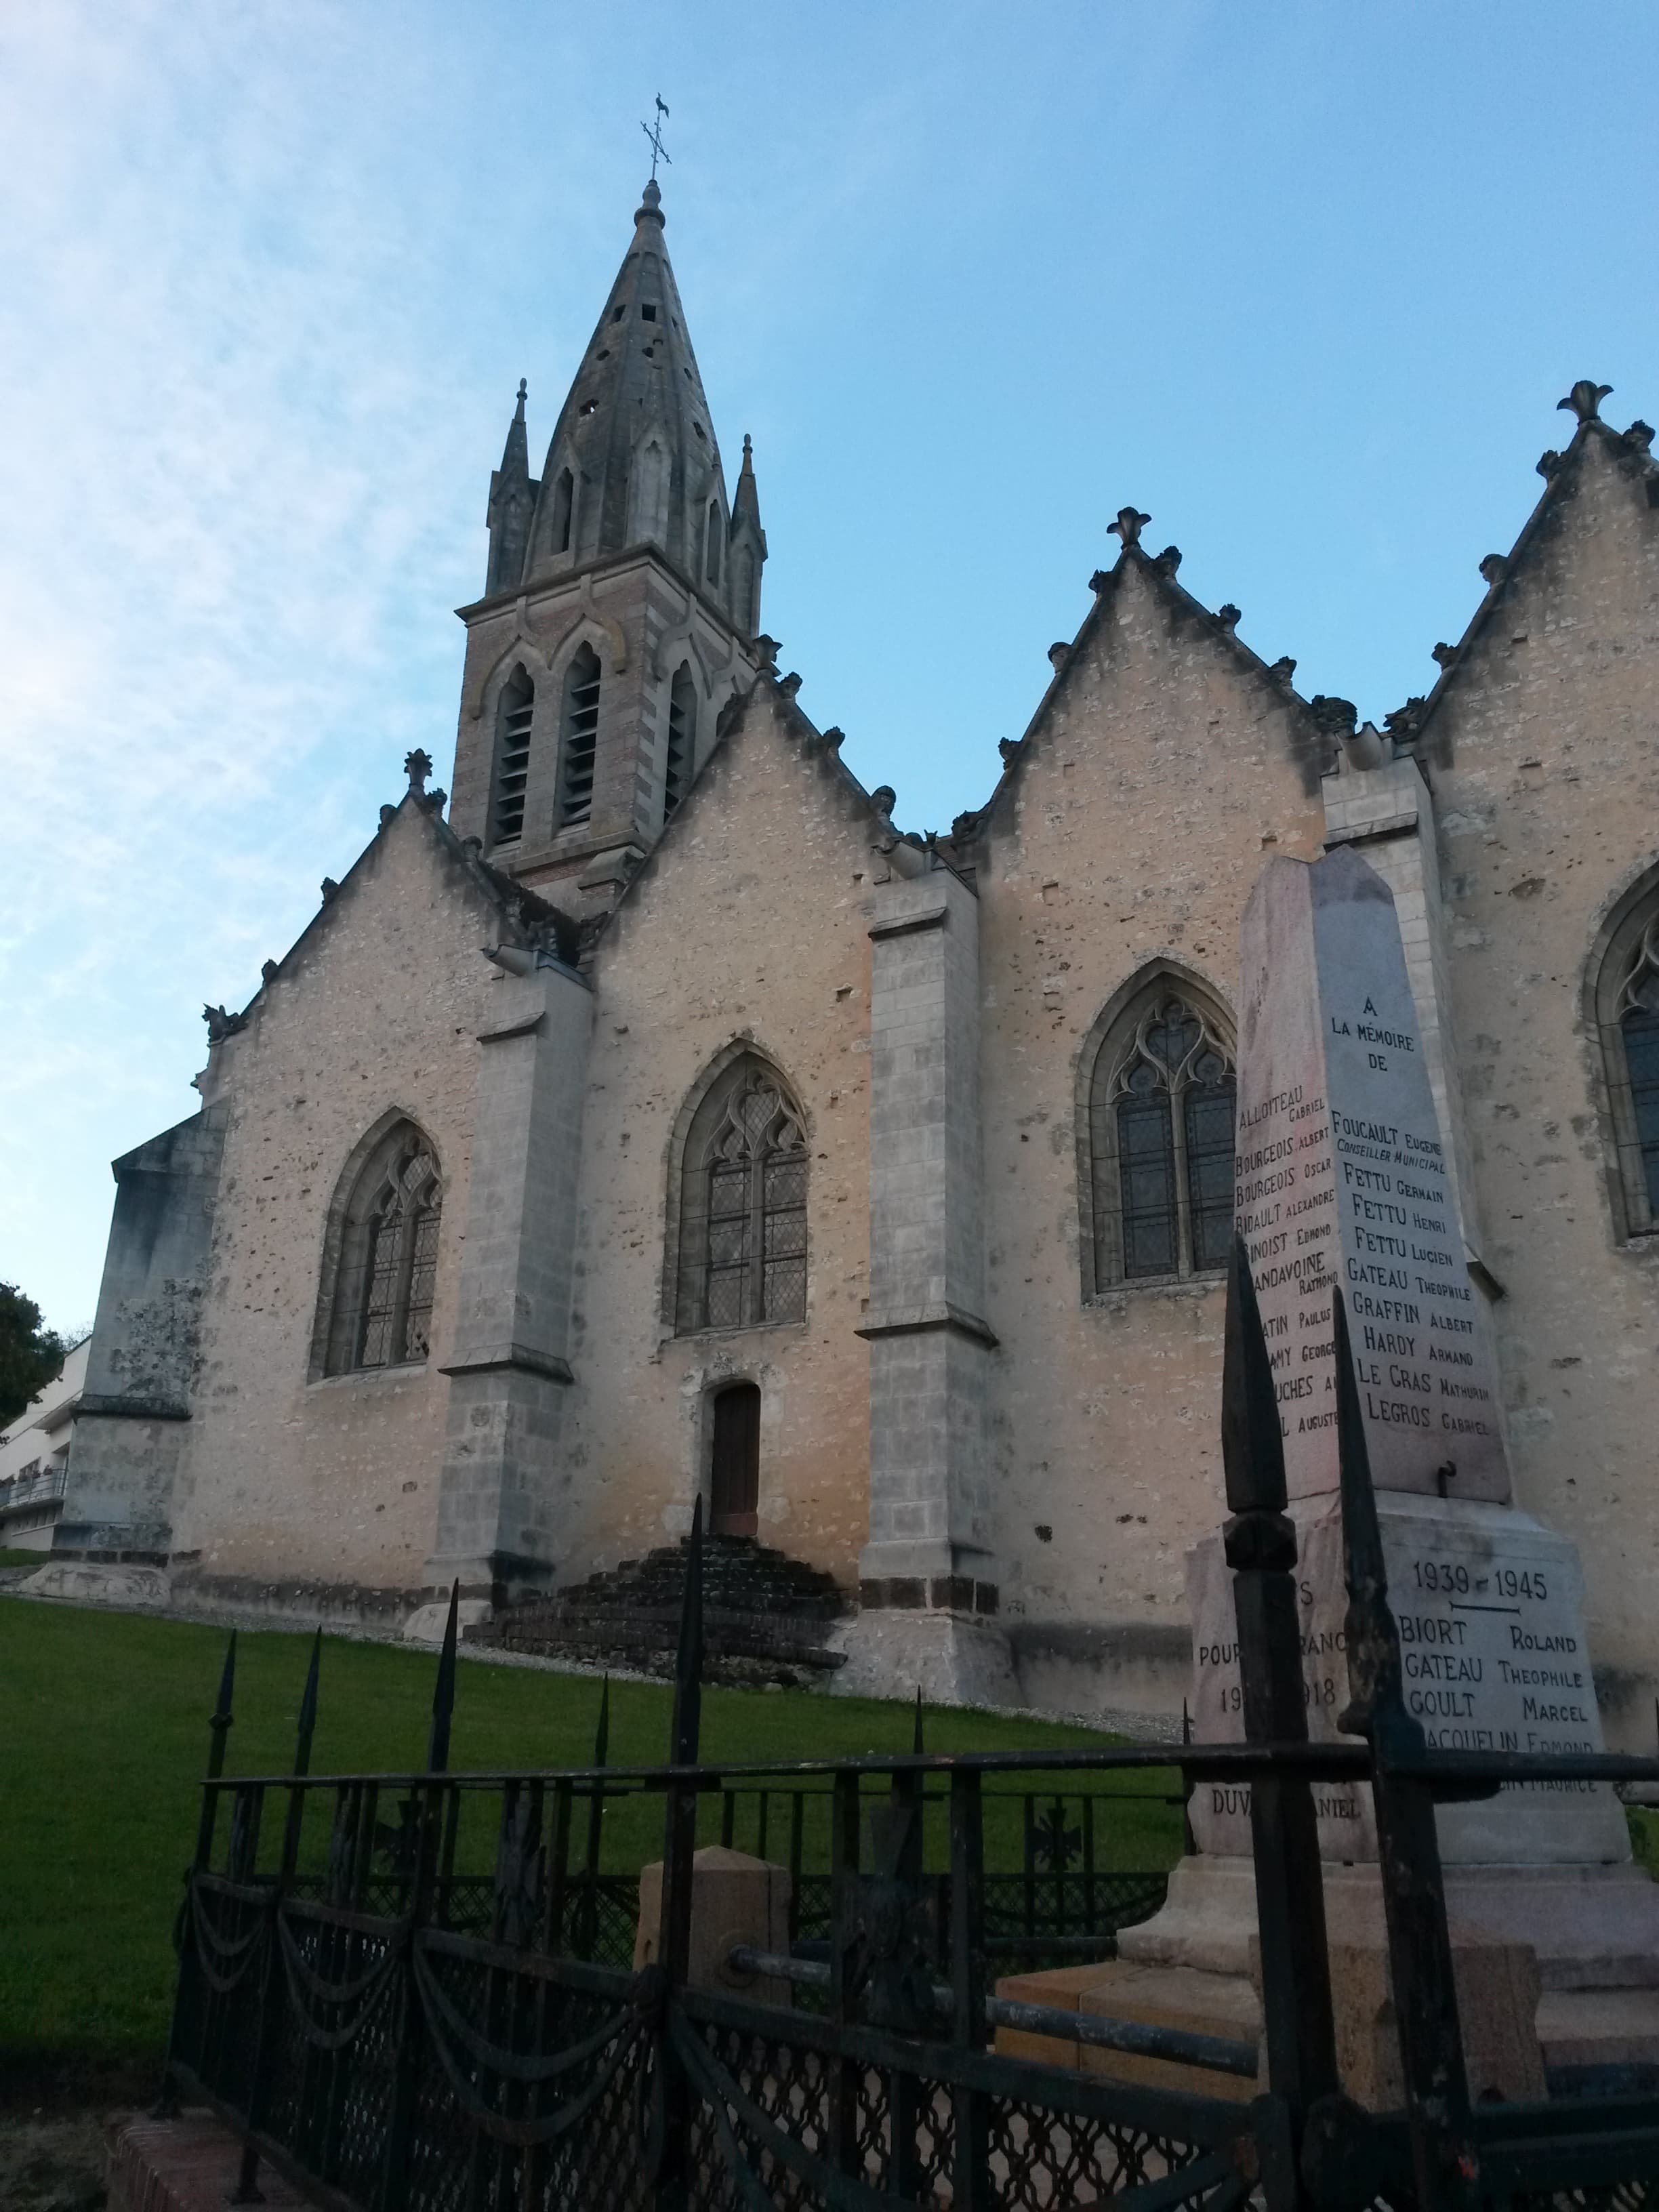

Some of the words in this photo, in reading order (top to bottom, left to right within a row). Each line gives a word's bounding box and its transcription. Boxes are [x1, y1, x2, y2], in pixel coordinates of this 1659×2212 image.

[1363, 996, 1378, 1016] A
[1332, 1018, 1350, 1036] LA
[1357, 1022, 1414, 1052] MÉMOIRE
[1368, 1054, 1387, 1071] DE
[1240, 1085, 1303, 1130] ALLOITEAU
[1289, 1098, 1325, 1122] GABRIEL
[1331, 1110, 1398, 1145] FOUCAULT
[1405, 1134, 1442, 1155] EUGENE
[1236, 1137, 1293, 1177] BOURGEOIS
[1299, 1127, 1329, 1150] ALBERT
[1337, 1139, 1391, 1162] CONSEILLER
[1394, 1151, 1445, 1174] MUNICIPAL
[1237, 1168, 1294, 1207] BOURGEOIS
[1305, 1158, 1331, 1179] OSCAR
[1343, 1162, 1391, 1192] FETTU
[1397, 1181, 1443, 1204] GERMAIN
[1236, 1203, 1281, 1236] BIDAULT
[1286, 1189, 1334, 1218] ALEXANDRE
[1352, 1193, 1406, 1225] FETTU
[1413, 1213, 1446, 1233] HENRI
[1297, 1224, 1331, 1246] EDMOND
[1355, 1226, 1406, 1258] FETTU
[1411, 1244, 1453, 1266] LUCIEN
[1254, 1252, 1325, 1292] ANDAVOINE
[1347, 1258, 1408, 1290] GATEAU
[1415, 1277, 1471, 1301] THEOPHILE
[1263, 1315, 1288, 1338] ATIN
[1299, 1309, 1330, 1328] PAULUS
[1353, 1292, 1420, 1324] GRAFFIN
[1431, 1313, 1473, 1334] ALBERT
[1270, 1347, 1291, 1370] AMY
[1364, 1326, 1415, 1356] HARDY
[1429, 1345, 1473, 1366] ARMAND
[1275, 1375, 1313, 1402] UCHES
[1357, 1358, 1380, 1385] LE
[1389, 1365, 1431, 1393] GRAS
[1440, 1378, 1490, 1401] MATHURIN
[1298, 1412, 1338, 1433] AUGUSTE
[1367, 1393, 1430, 1427] LEGROS
[1441, 1413, 1490, 1435] GABRIEL
[1300, 1632, 1346, 1655] RANC
[1399, 1616, 1467, 1645] BIORT
[1510, 1626, 1576, 1652] ROLAND
[1405, 1654, 1482, 1682] GATEAU
[1498, 1660, 1583, 1687] THEOPHILE
[1410, 1691, 1475, 1717] GOULT
[1523, 1696, 1588, 1722] MARCEL
[1427, 1729, 1518, 1750] ACQUELIN
[1212, 1789, 1252, 1816] DUV
[1317, 1798, 1361, 1819] NIEL
